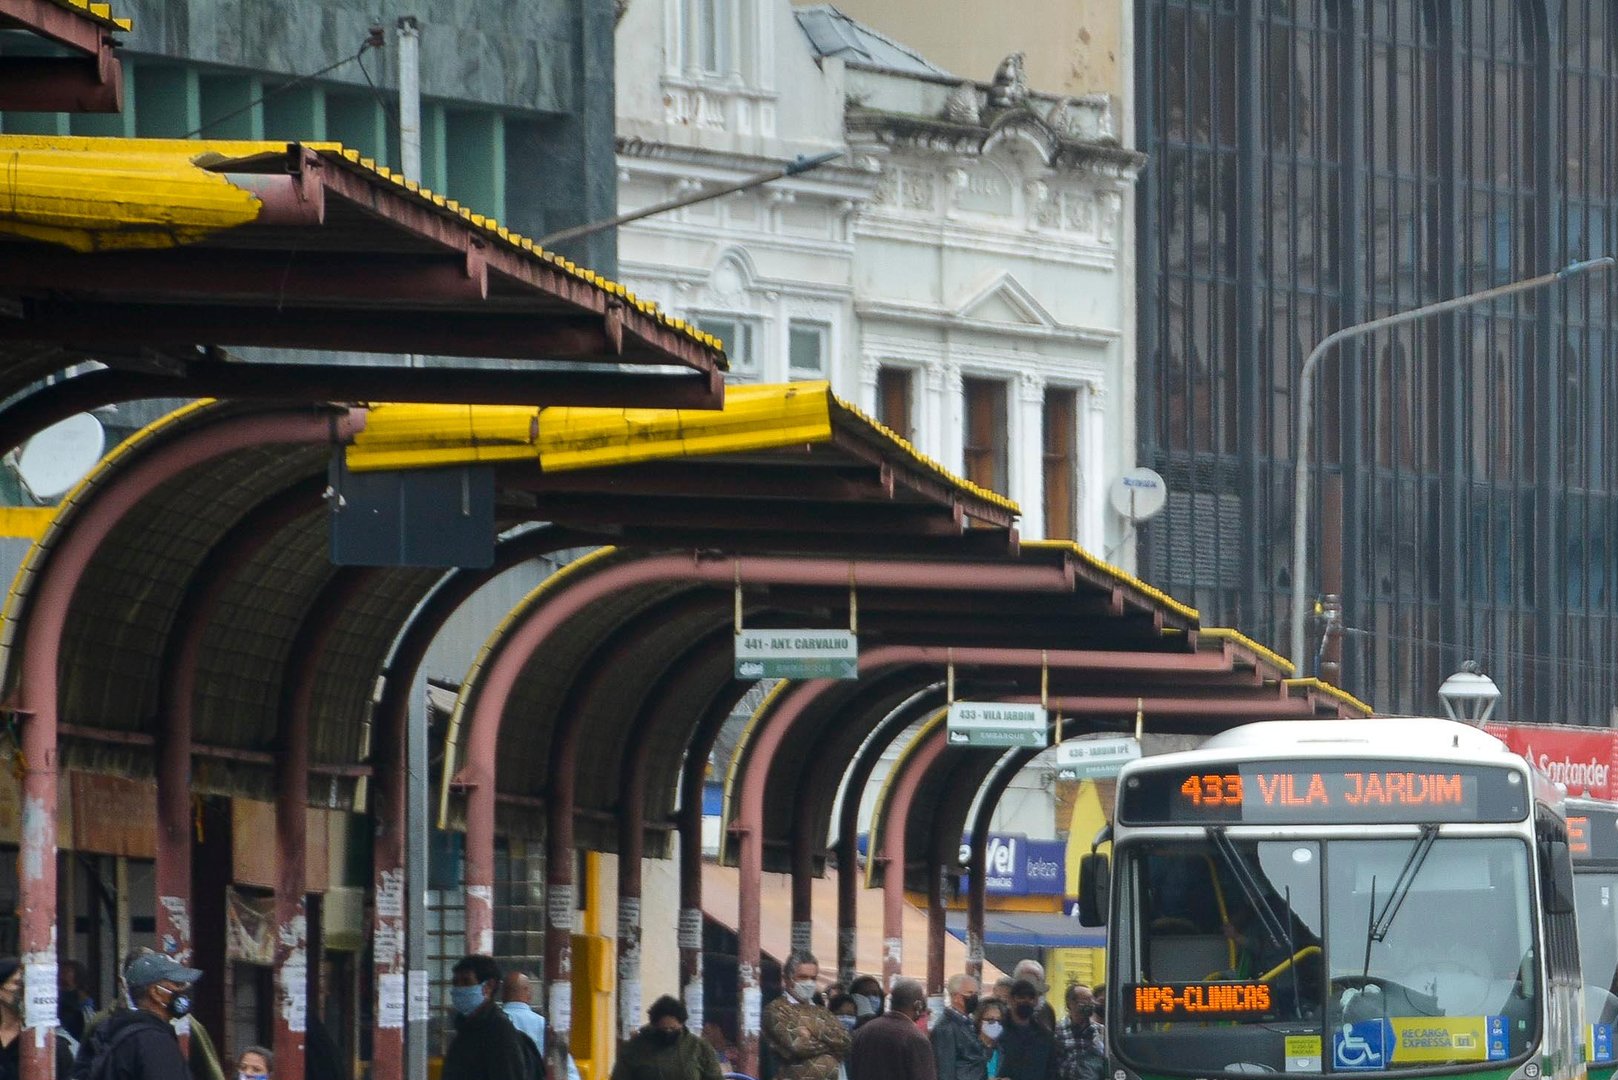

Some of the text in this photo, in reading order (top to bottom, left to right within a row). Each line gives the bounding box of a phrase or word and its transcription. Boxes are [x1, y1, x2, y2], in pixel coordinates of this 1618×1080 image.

[744, 638, 763, 649] 441
[795, 638, 849, 650] CARVALHO
[959, 710, 976, 720] 433
[983, 711, 1001, 720] VILA
[1003, 711, 1035, 721] JARDIM
[1540, 753, 1610, 787] Santander
[1180, 772, 1462, 804] 433 VILA JARDIM
[1135, 984, 1271, 1013] HPS-CLINICAS
[1402, 1028, 1449, 1038] RECARGA
[1403, 1038, 1452, 1048] EXPRESSA
